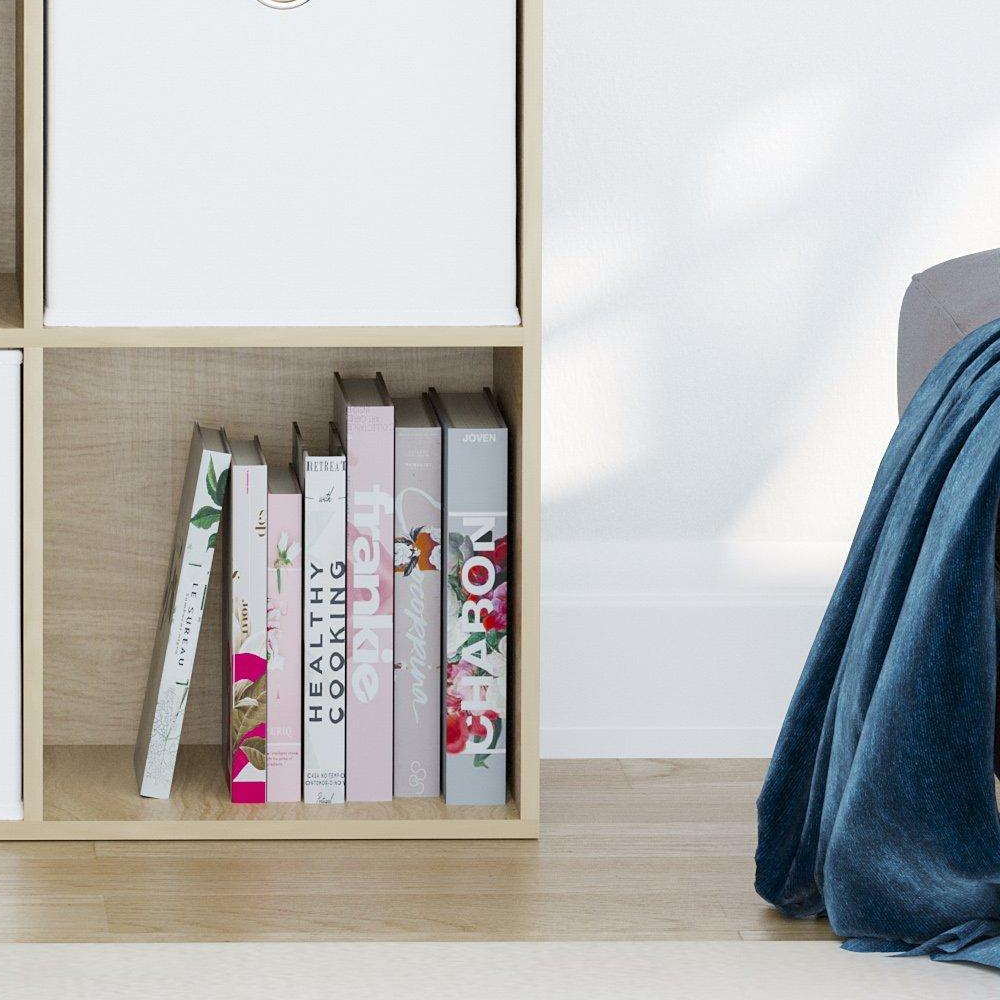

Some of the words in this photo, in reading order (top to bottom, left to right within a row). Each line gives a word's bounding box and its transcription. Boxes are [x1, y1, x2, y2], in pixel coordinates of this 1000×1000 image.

[306, 460, 346, 473] RETREAT
[462, 433, 496, 443] JOVEN
[177, 605, 193, 664] SUREAU
[189, 582, 199, 600] LE
[309, 561, 324, 722] HEALTHY
[329, 560, 346, 724] COOKING
[351, 483, 393, 704] frankie
[459, 515, 496, 754] CHABON
